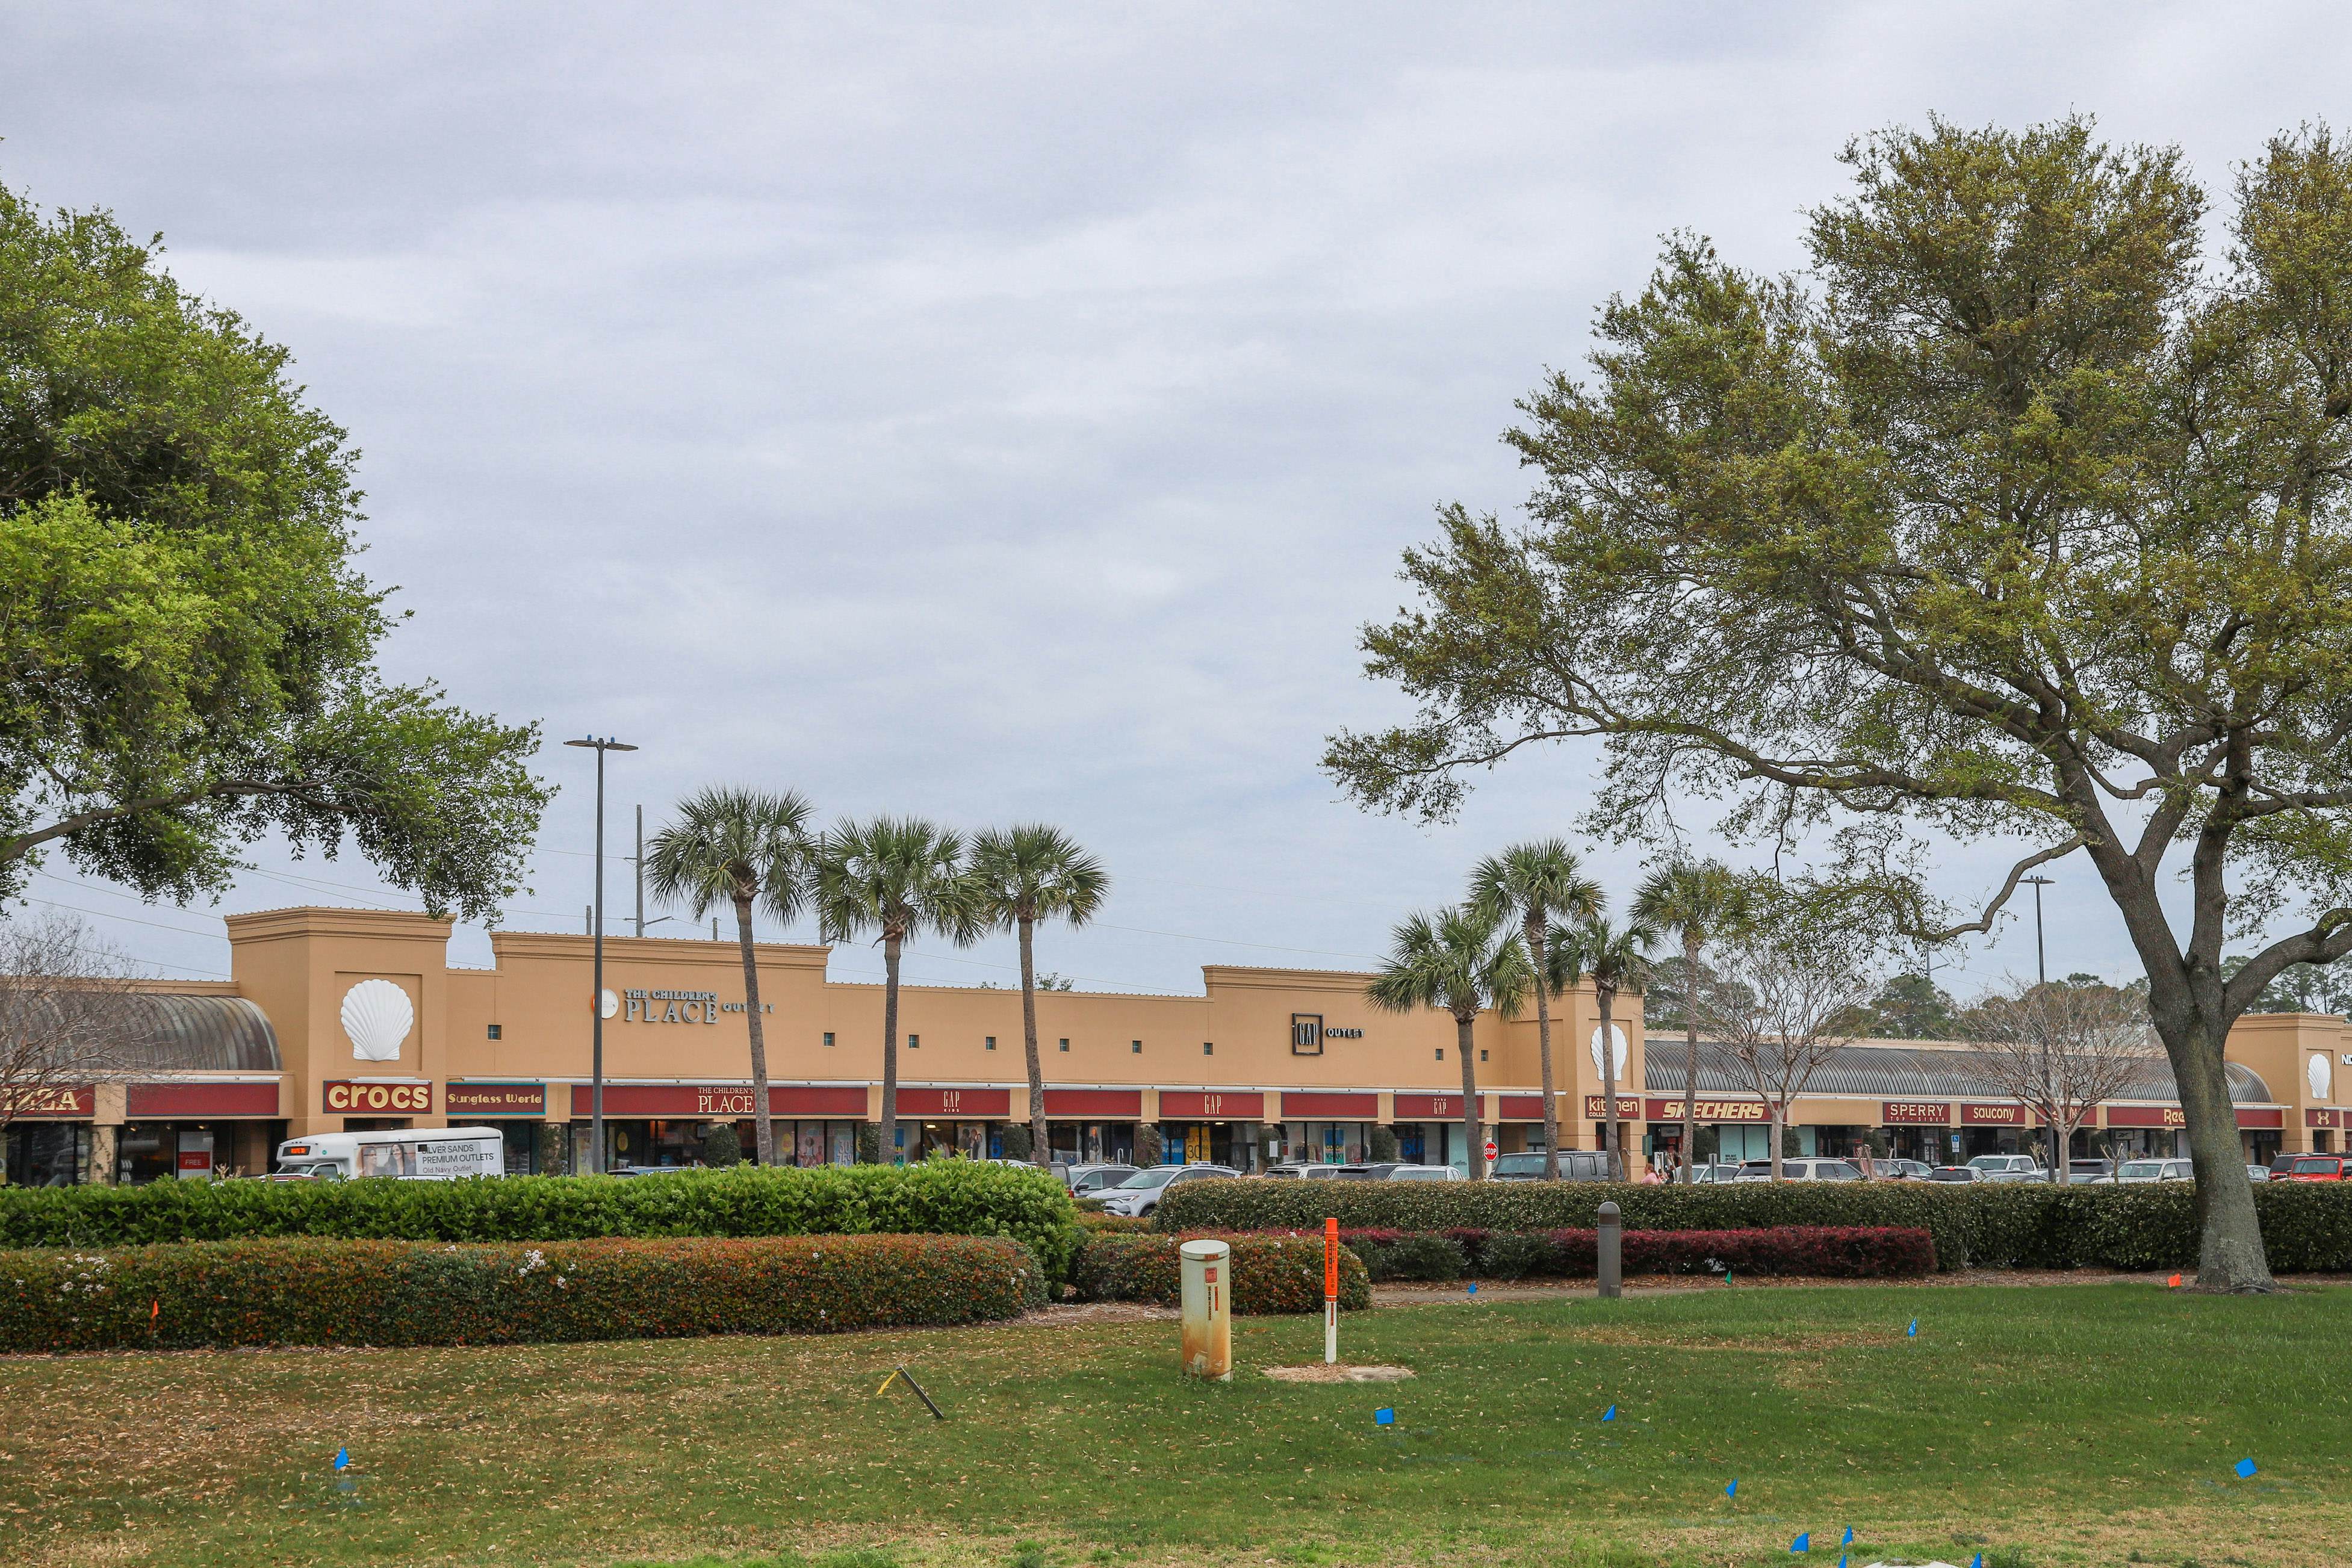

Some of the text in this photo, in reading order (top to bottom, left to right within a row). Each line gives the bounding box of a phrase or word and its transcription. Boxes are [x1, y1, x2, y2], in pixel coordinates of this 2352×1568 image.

[624, 989, 718, 1001] THE CHILDREN'S
[625, 999, 718, 1023] PLACE
[722, 1001, 775, 1014] OUTET
[1298, 1023, 1318, 1045] GAP
[1326, 1028, 1365, 1038] OUTLET
[328, 1085, 429, 1109] crocs
[448, 1093, 542, 1105] Sunglass World
[698, 1095, 754, 1113] PLACE
[943, 1091, 960, 1108] GAP
[1205, 1094, 1222, 1114] GAP
[1434, 1102, 1447, 1115] GAP
[1662, 1102, 1765, 1119] SKECHERS
[1890, 1104, 1944, 1117] SPERRY
[1973, 1106, 2015, 1122] saucony
[447, 1144, 474, 1153] SANDS
[423, 1153, 494, 1164] PREMIUM OUTLETS
